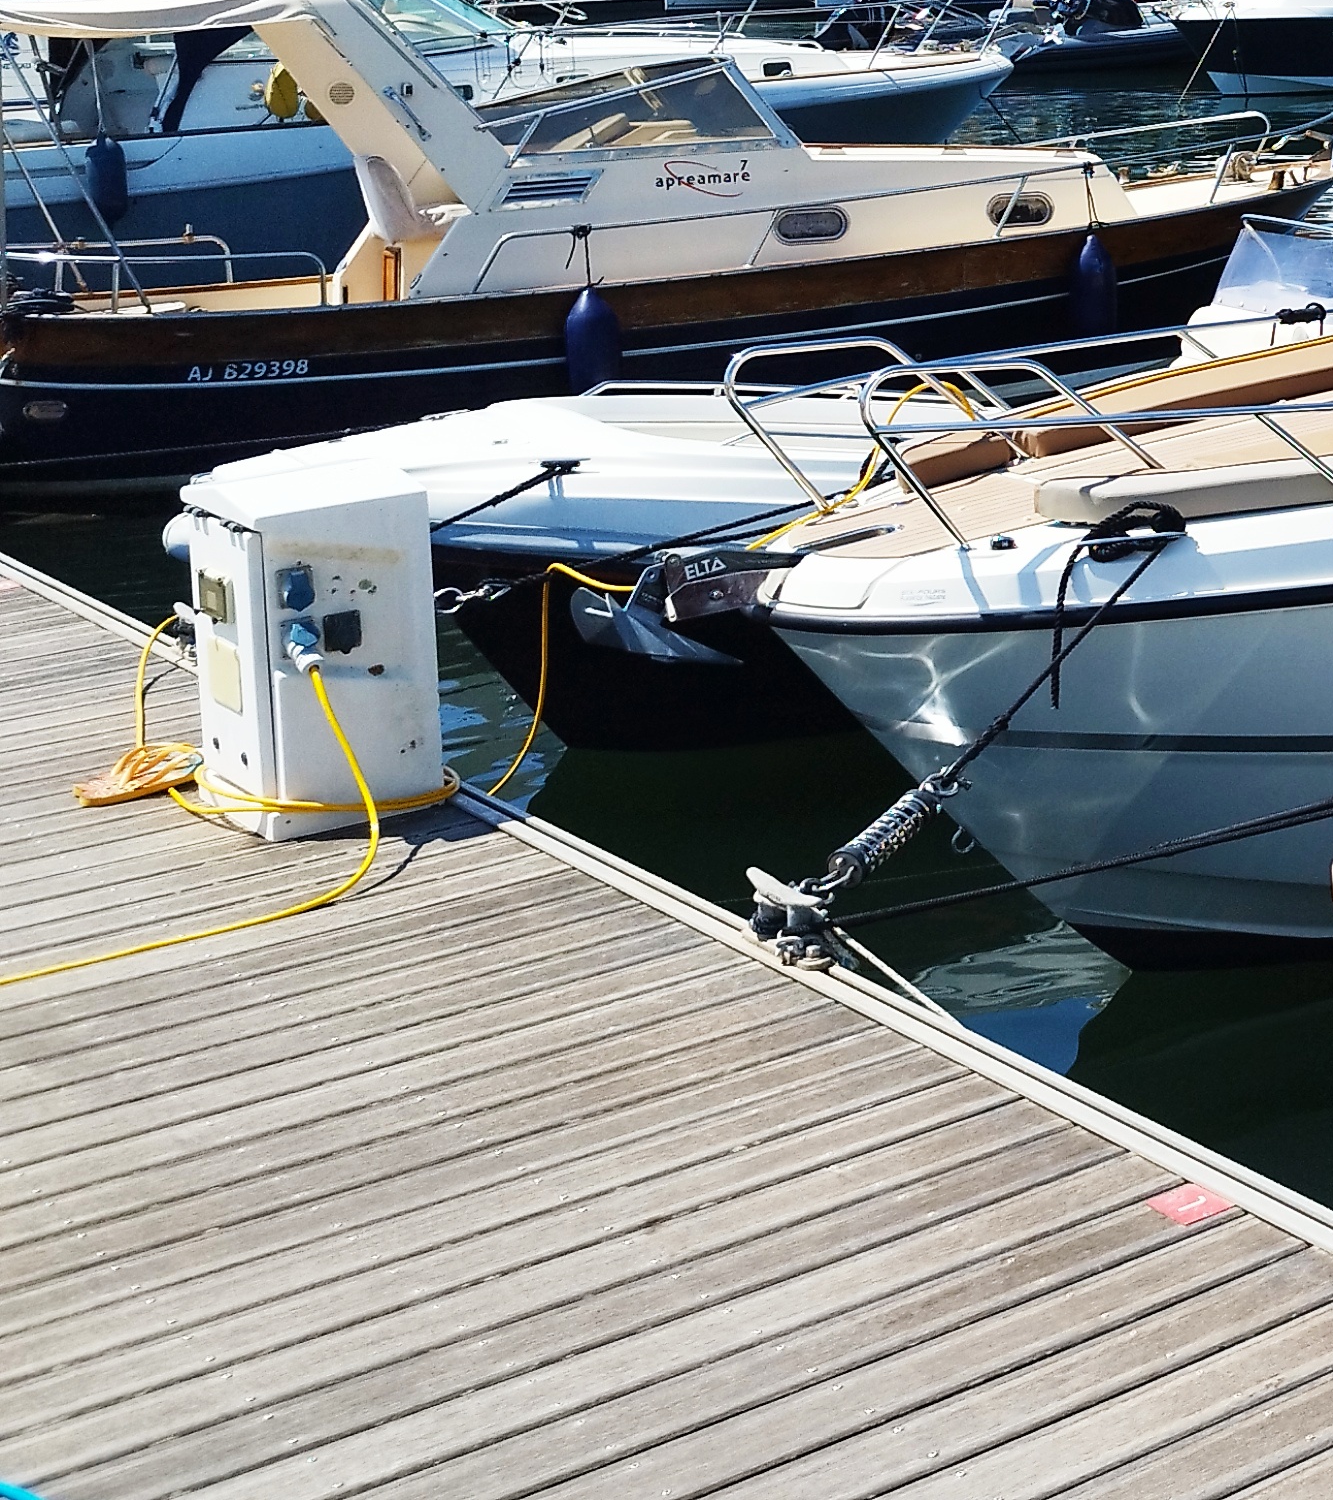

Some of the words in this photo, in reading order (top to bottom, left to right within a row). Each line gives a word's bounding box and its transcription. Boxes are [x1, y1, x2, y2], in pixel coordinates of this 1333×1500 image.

[740, 159, 748, 171] 7
[655, 171, 751, 191] apreamare
[187, 366, 213, 381] AJ
